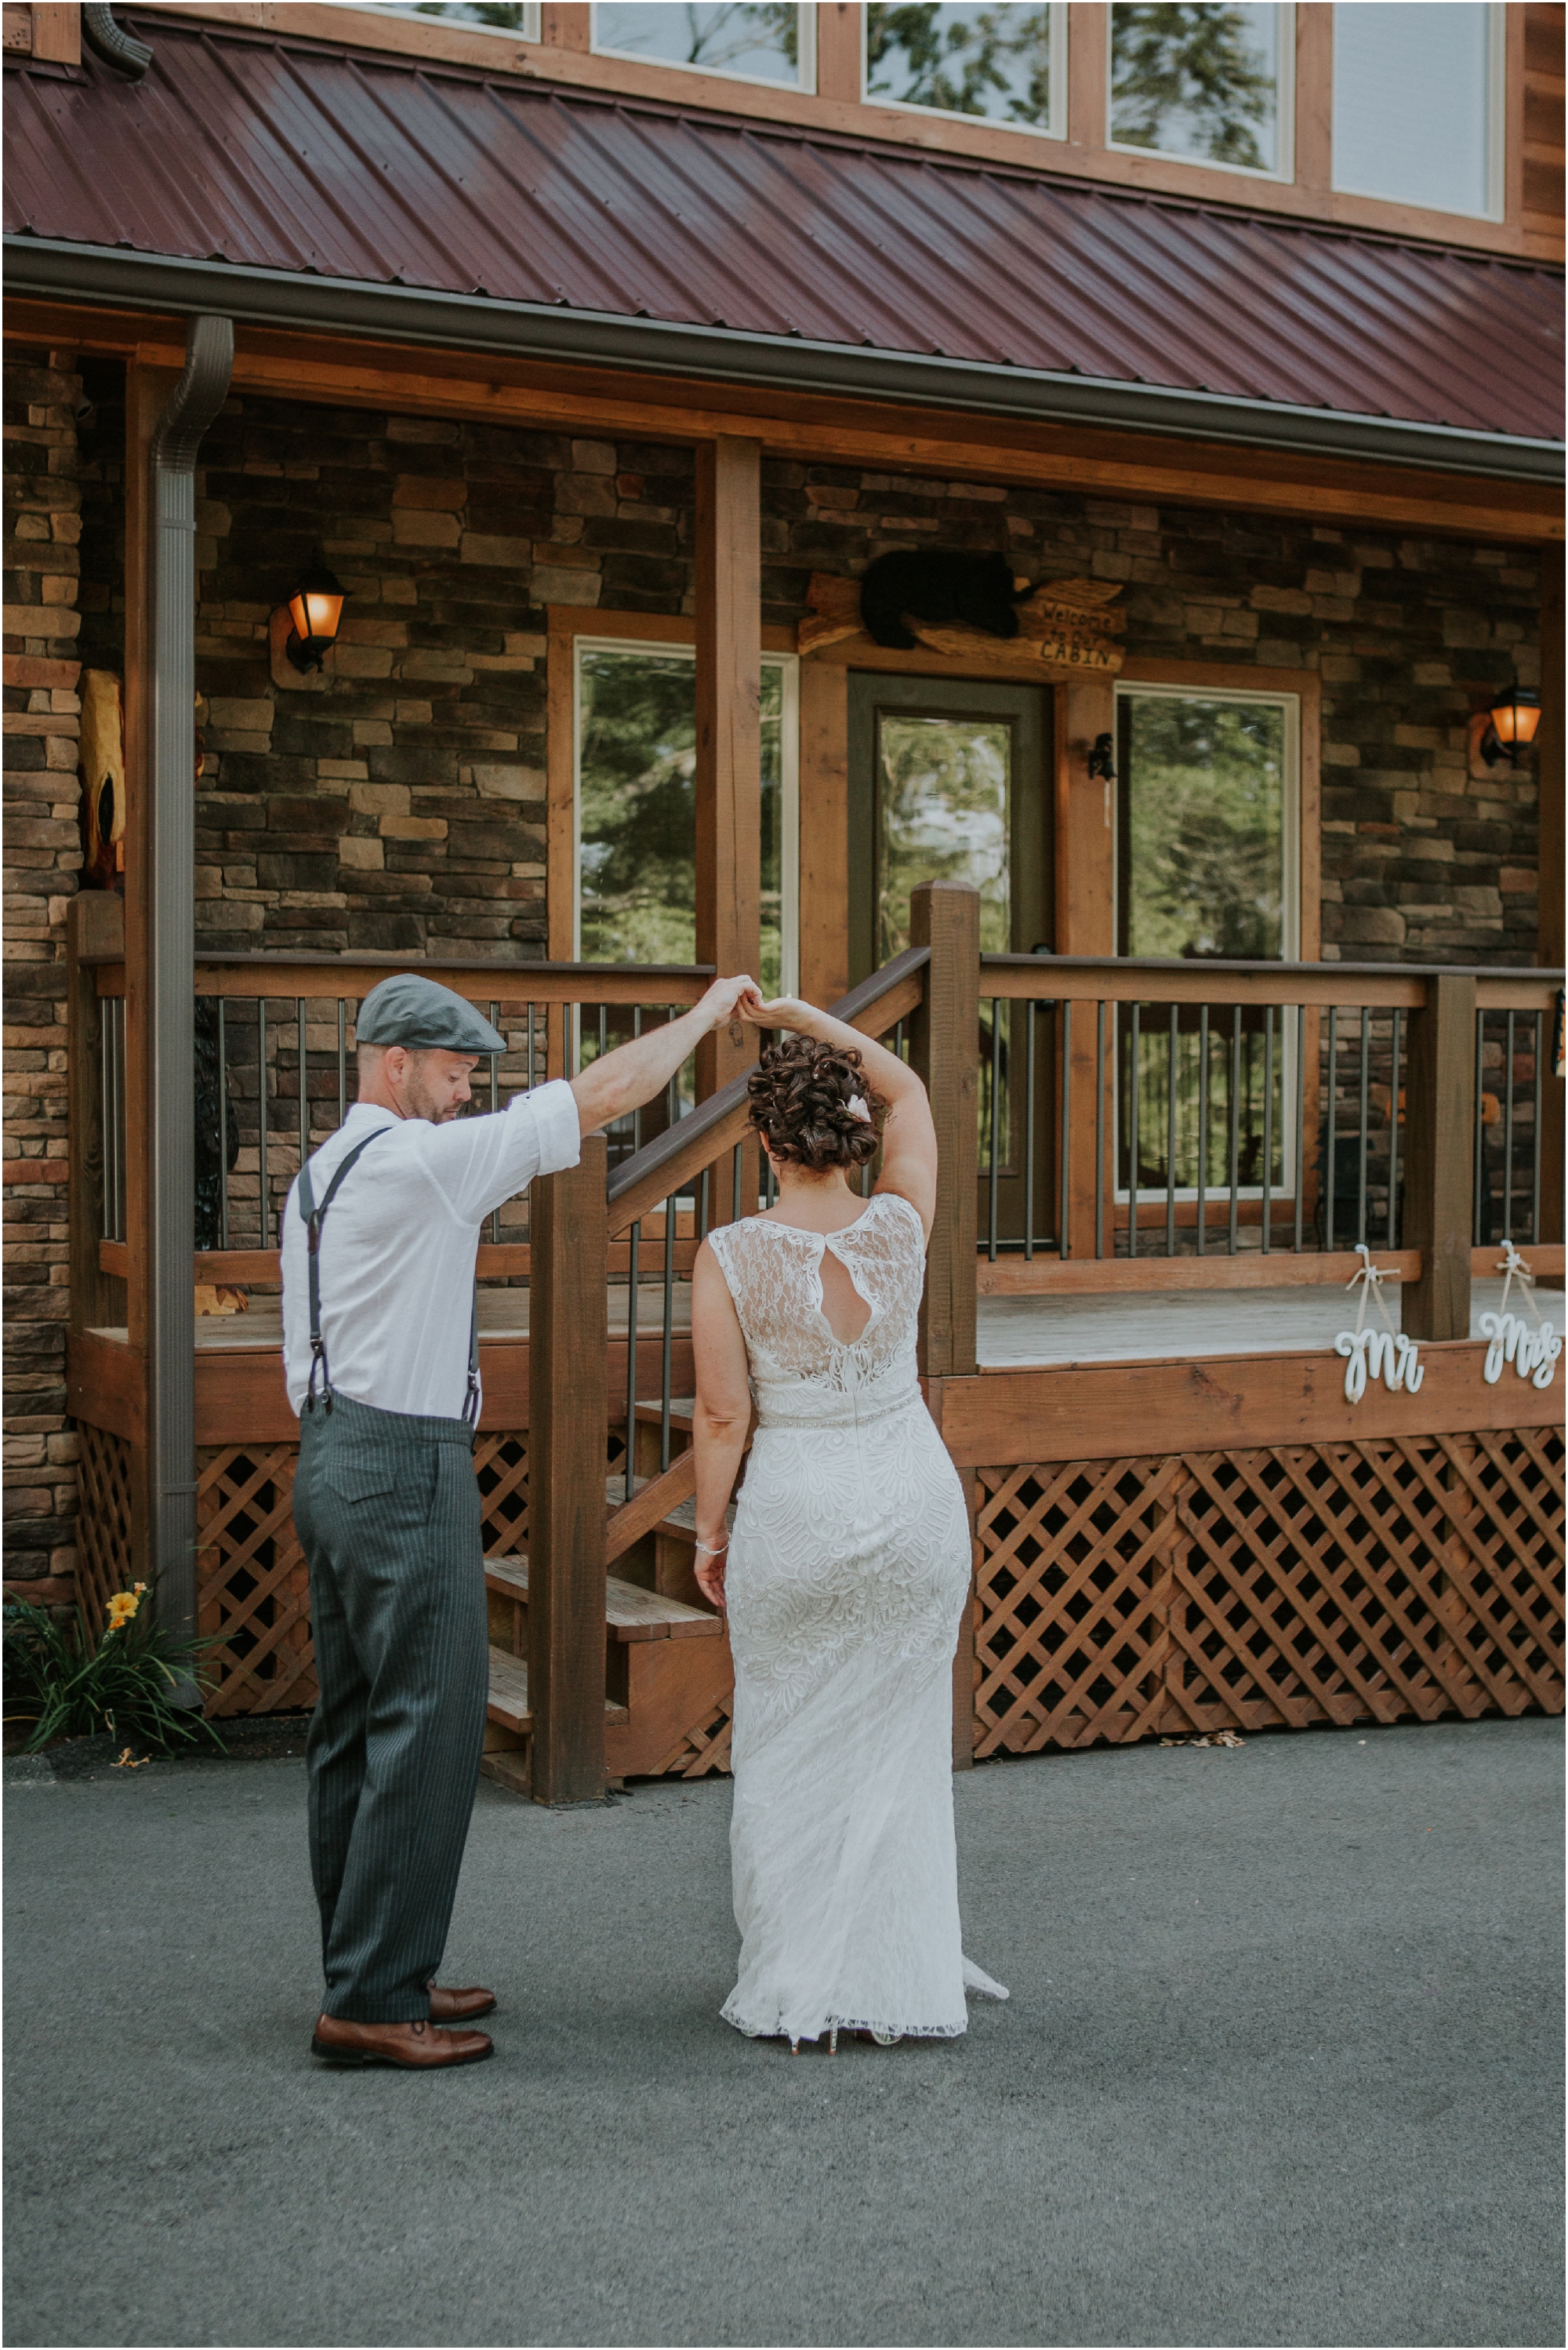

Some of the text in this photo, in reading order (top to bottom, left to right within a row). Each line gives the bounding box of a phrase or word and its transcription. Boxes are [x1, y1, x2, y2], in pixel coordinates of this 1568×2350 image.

[1043, 602, 1112, 628] Welcome
[1049, 627, 1066, 641] to
[1041, 640, 1111, 666] CABIN
[1479, 1311, 1563, 1389] Mrs
[1334, 1328, 1425, 1404] Mr
